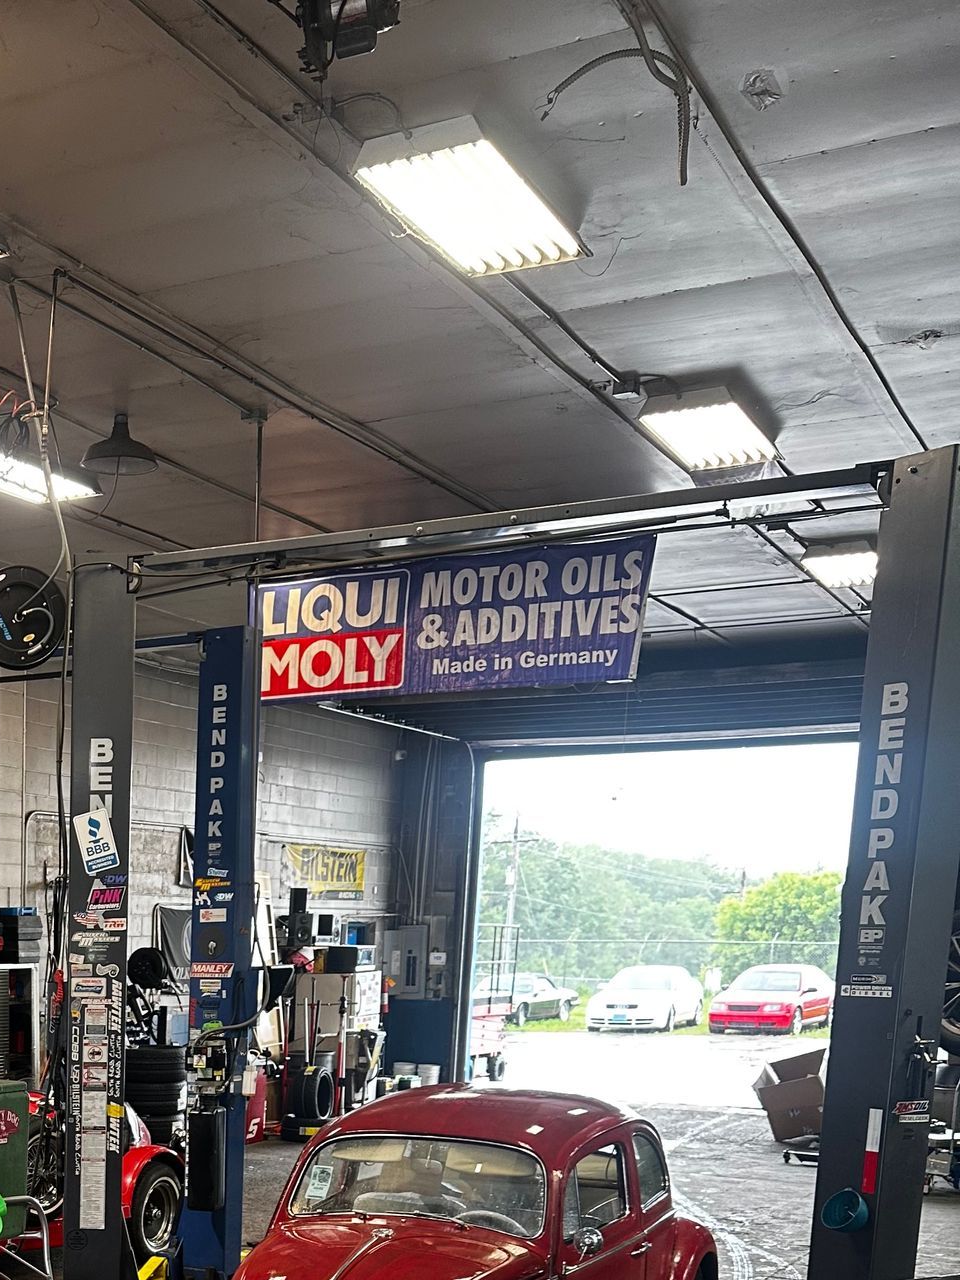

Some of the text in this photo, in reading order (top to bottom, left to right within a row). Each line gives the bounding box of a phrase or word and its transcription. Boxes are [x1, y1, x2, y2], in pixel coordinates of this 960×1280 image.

[421, 550, 642, 608] MOTOR OILS
[262, 578, 398, 637] LIQUI
[261, 633, 401, 692] MOLY
[433, 648, 618, 675] Made in Germany
[86, 842, 110, 856] BBB
[300, 848, 358, 882] BILSTEIN
[860, 930, 883, 942] BP
[193, 964, 227, 973] MANLEY
[111, 979, 122, 1033] RAWTEK
[72, 1084, 80, 1115] BILSTEIN
[896, 1101, 928, 1113] AMSOIL
[246, 1118, 260, 1139] 5
